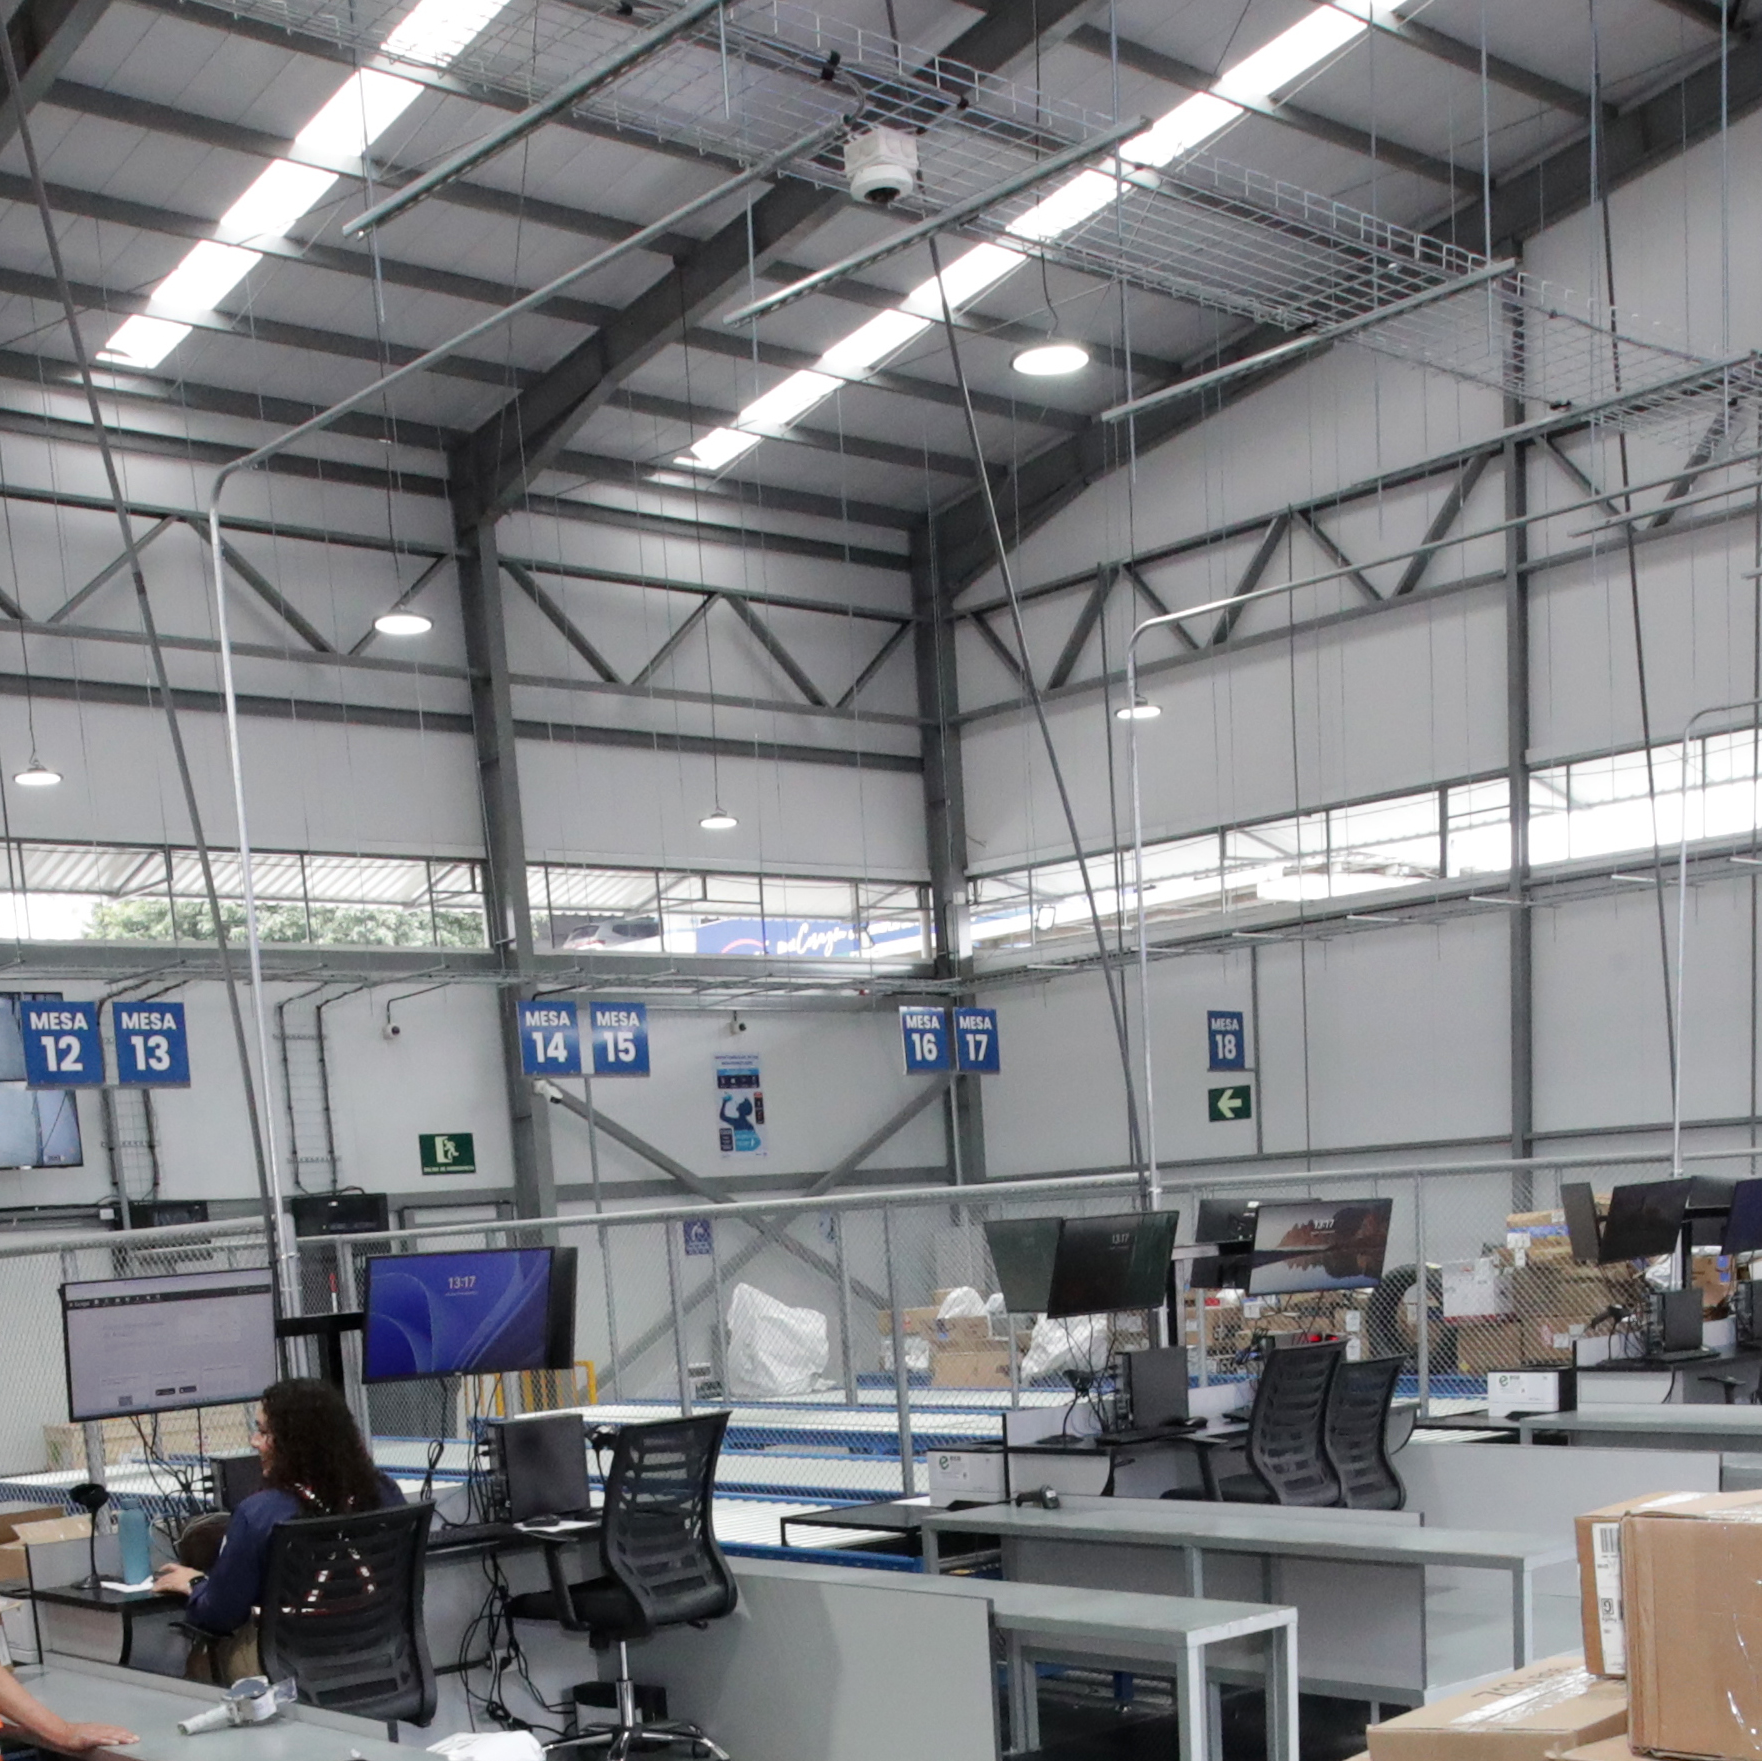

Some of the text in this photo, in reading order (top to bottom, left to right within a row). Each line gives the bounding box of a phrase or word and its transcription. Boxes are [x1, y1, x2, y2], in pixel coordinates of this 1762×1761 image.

[30, 1012, 88, 1031] MESA
[121, 1012, 176, 1030] MESA
[525, 1010, 571, 1027] MESA
[596, 1010, 639, 1026] MESA
[906, 1014, 940, 1029] MESA
[959, 1015, 992, 1030] MESA
[1211, 1018, 1240, 1032] MESA
[41, 1036, 83, 1071] 12
[131, 1035, 171, 1071] 13
[531, 1032, 568, 1063] 14
[603, 1031, 637, 1062] 15
[911, 1033, 938, 1061] 16
[966, 1034, 989, 1061] 17
[1215, 1034, 1237, 1060] 18
[1313, 1218, 1335, 1230] 13:17
[448, 1276, 475, 1290] 13:17
